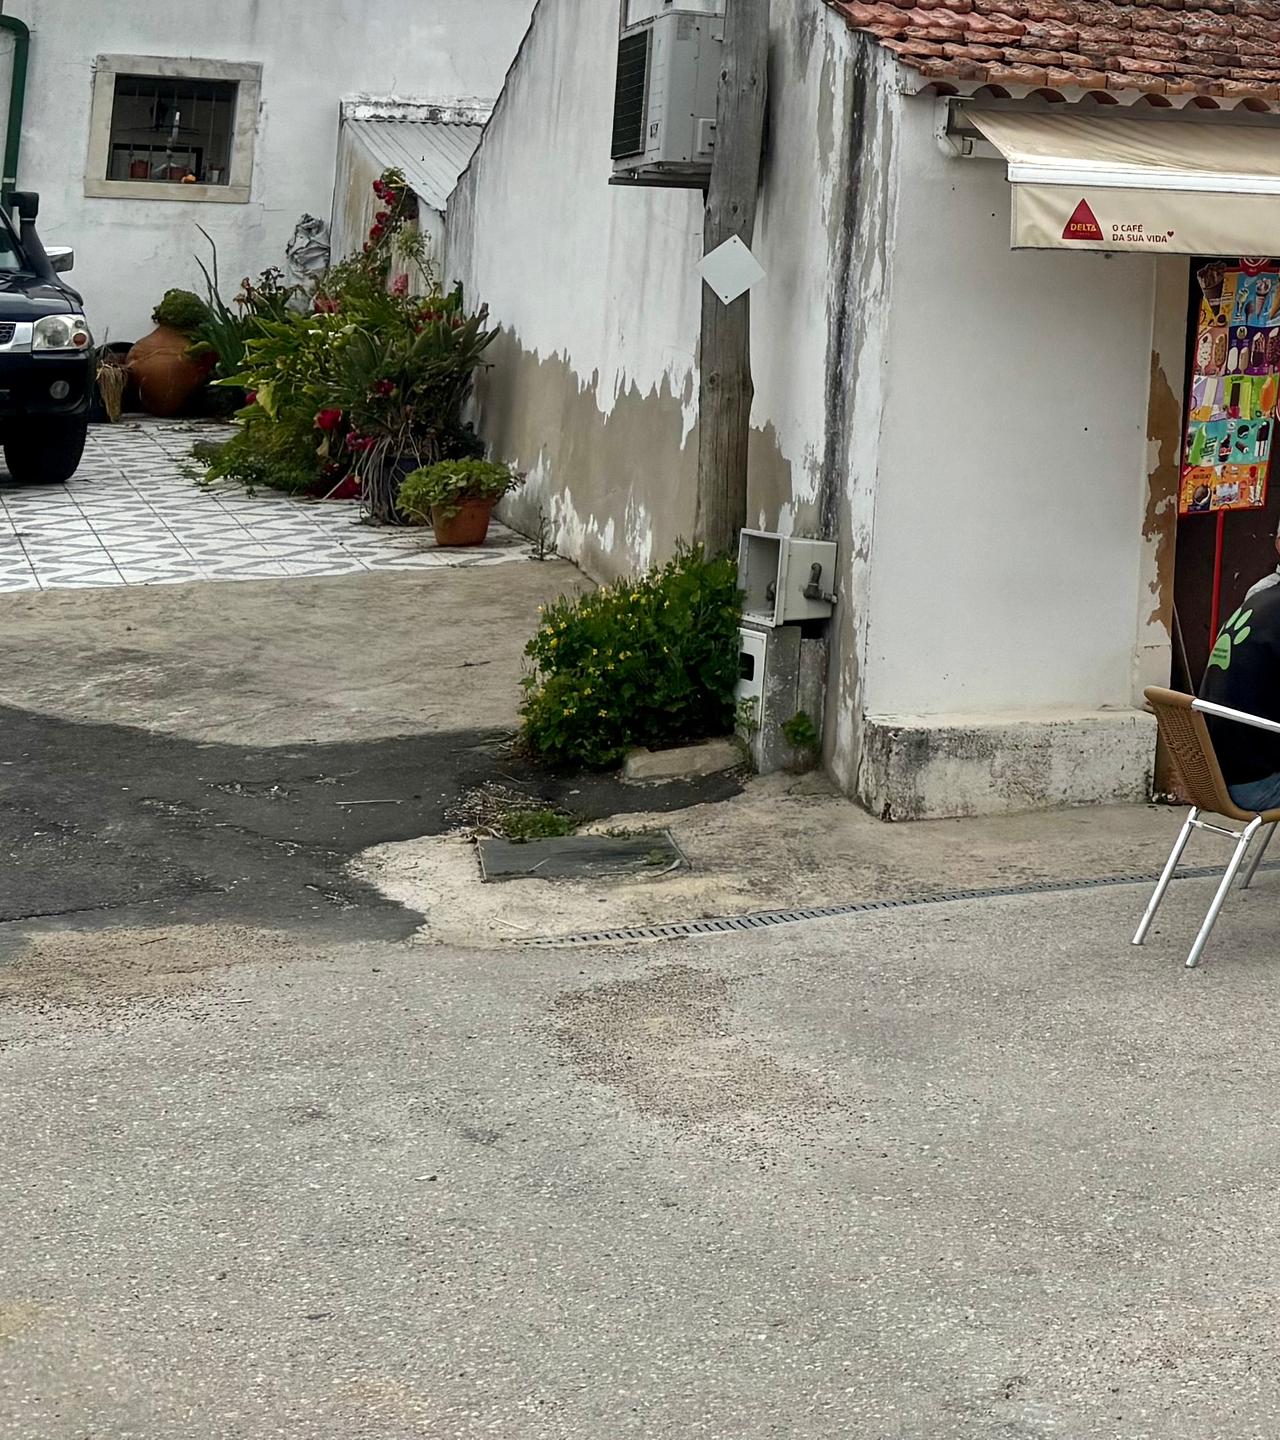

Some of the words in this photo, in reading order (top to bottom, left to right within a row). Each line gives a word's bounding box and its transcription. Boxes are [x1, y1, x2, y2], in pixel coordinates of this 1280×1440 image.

[1070, 223, 1097, 232] DELTA
[1112, 224, 1119, 232] O
[1112, 233, 1124, 242] DA
[1127, 234, 1144, 243] SUA
[1146, 234, 1168, 243] VIDA
